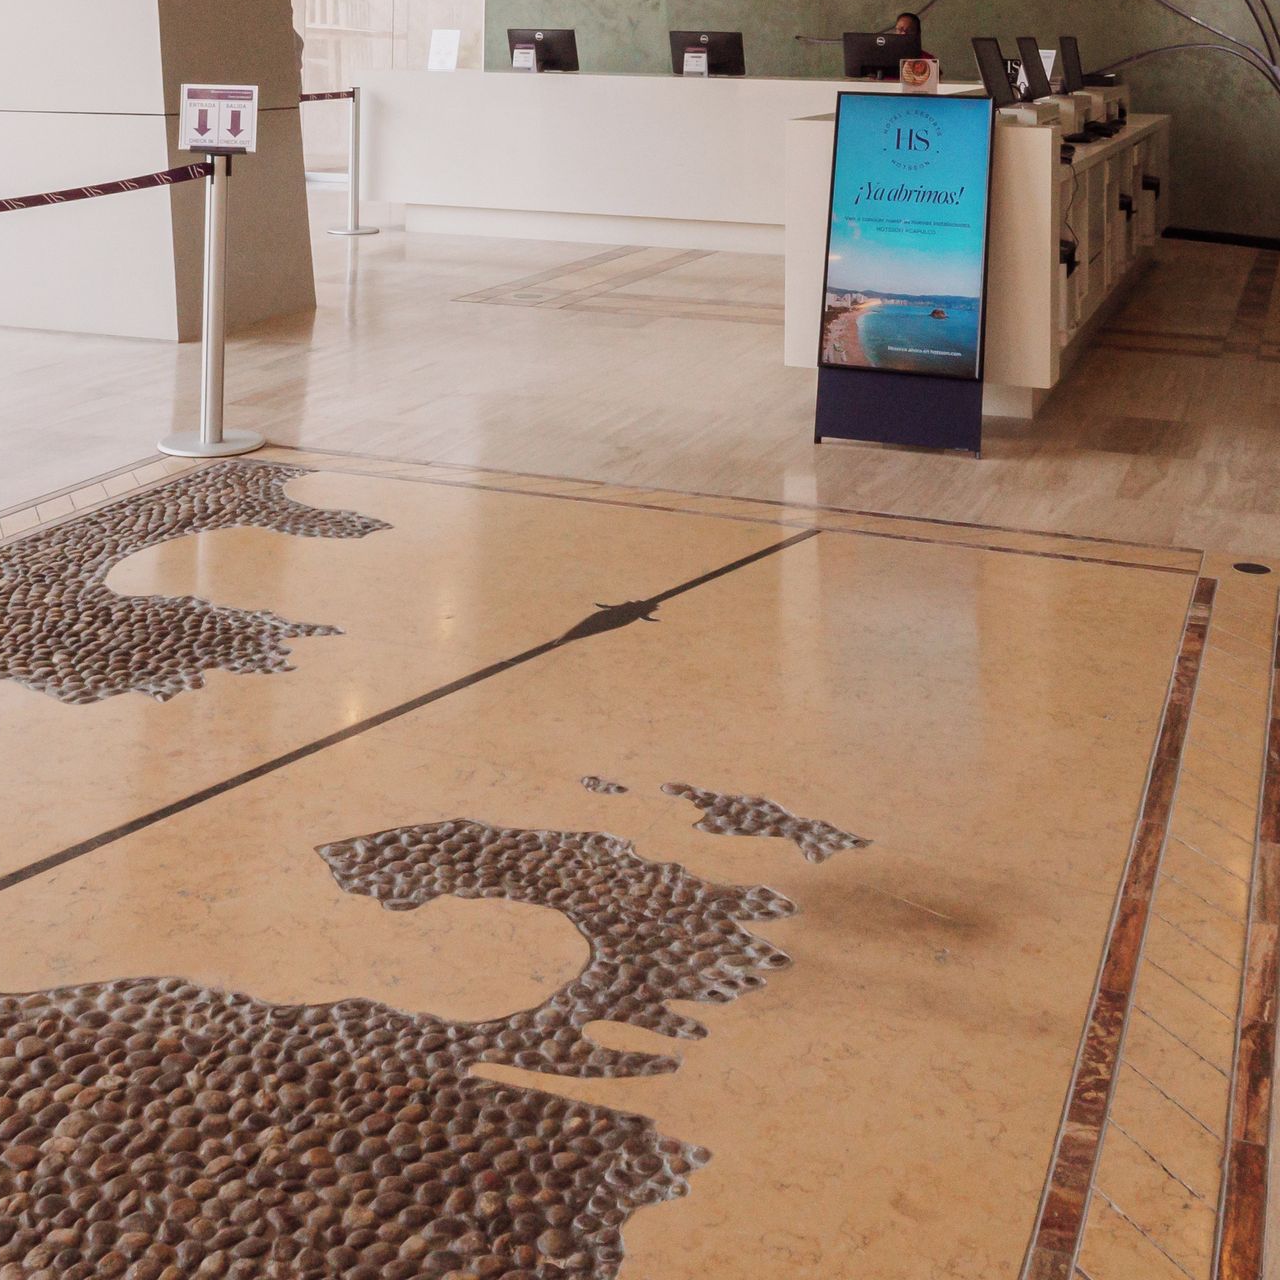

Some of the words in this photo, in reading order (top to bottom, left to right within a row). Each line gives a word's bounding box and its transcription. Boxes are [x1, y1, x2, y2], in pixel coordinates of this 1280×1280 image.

[895, 127, 931, 152] HS
[890, 159, 931, 171] HOTSSON
[854, 181, 886, 206] ¡Ya
[886, 183, 966, 206] abrimos!
